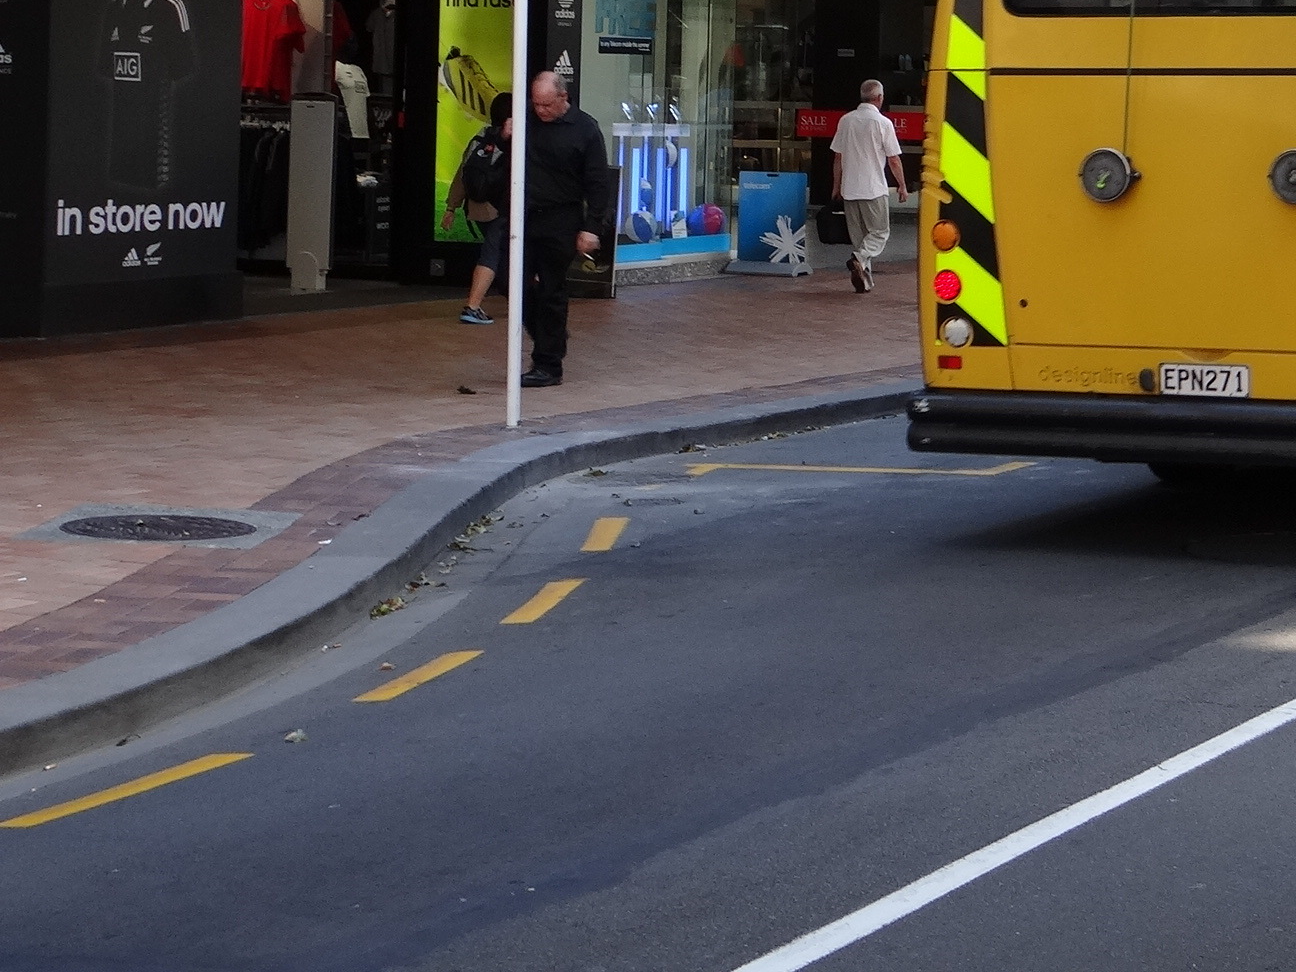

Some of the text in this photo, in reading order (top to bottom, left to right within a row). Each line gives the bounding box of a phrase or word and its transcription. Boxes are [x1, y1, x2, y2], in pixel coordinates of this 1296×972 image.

[554, 9, 575, 19] adidas
[116, 58, 138, 75] AIG
[800, 115, 827, 126] SALE
[57, 199, 225, 236] in store now
[1163, 367, 1244, 393] EPN271
